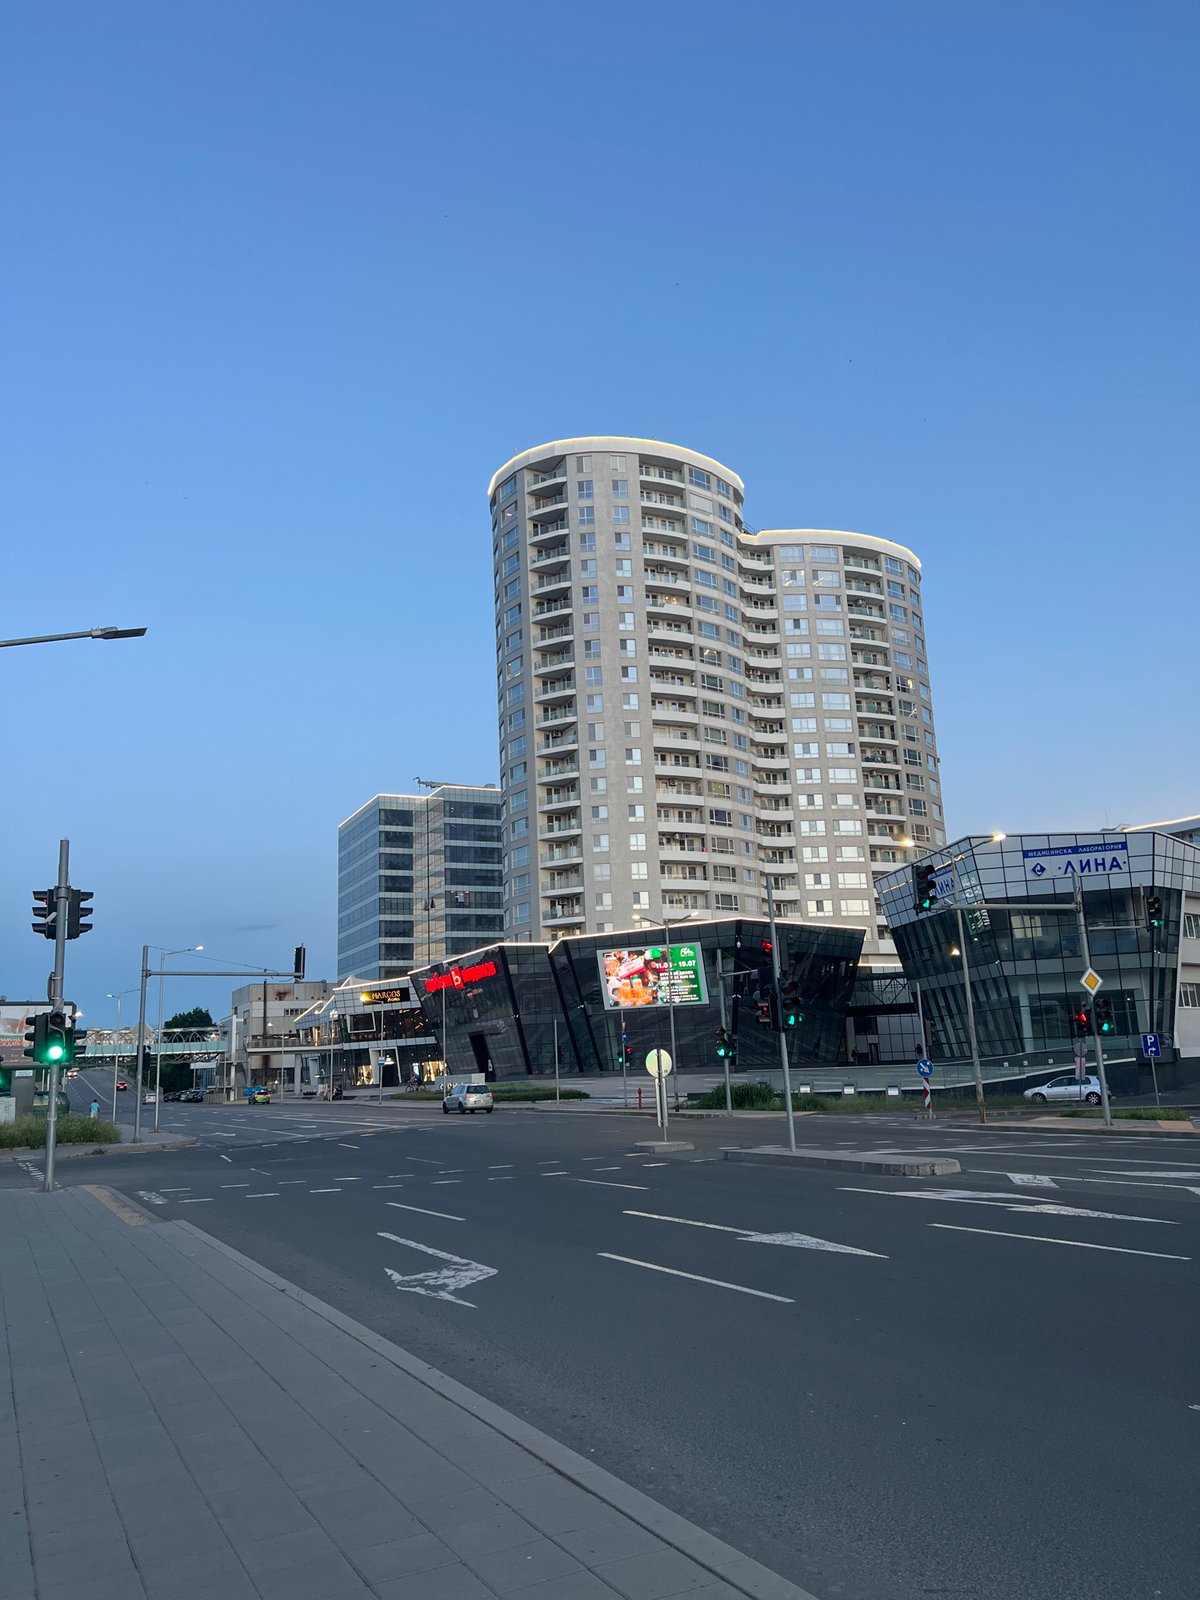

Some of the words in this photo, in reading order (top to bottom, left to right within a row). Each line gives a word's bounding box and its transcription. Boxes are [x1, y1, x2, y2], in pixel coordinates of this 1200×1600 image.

[1028, 848, 1072, 857] МЕДИЦИНСКА
[1078, 844, 1122, 852] ЛАБОРАТОРИЯ
[1147, 1035, 1154, 1046] P
